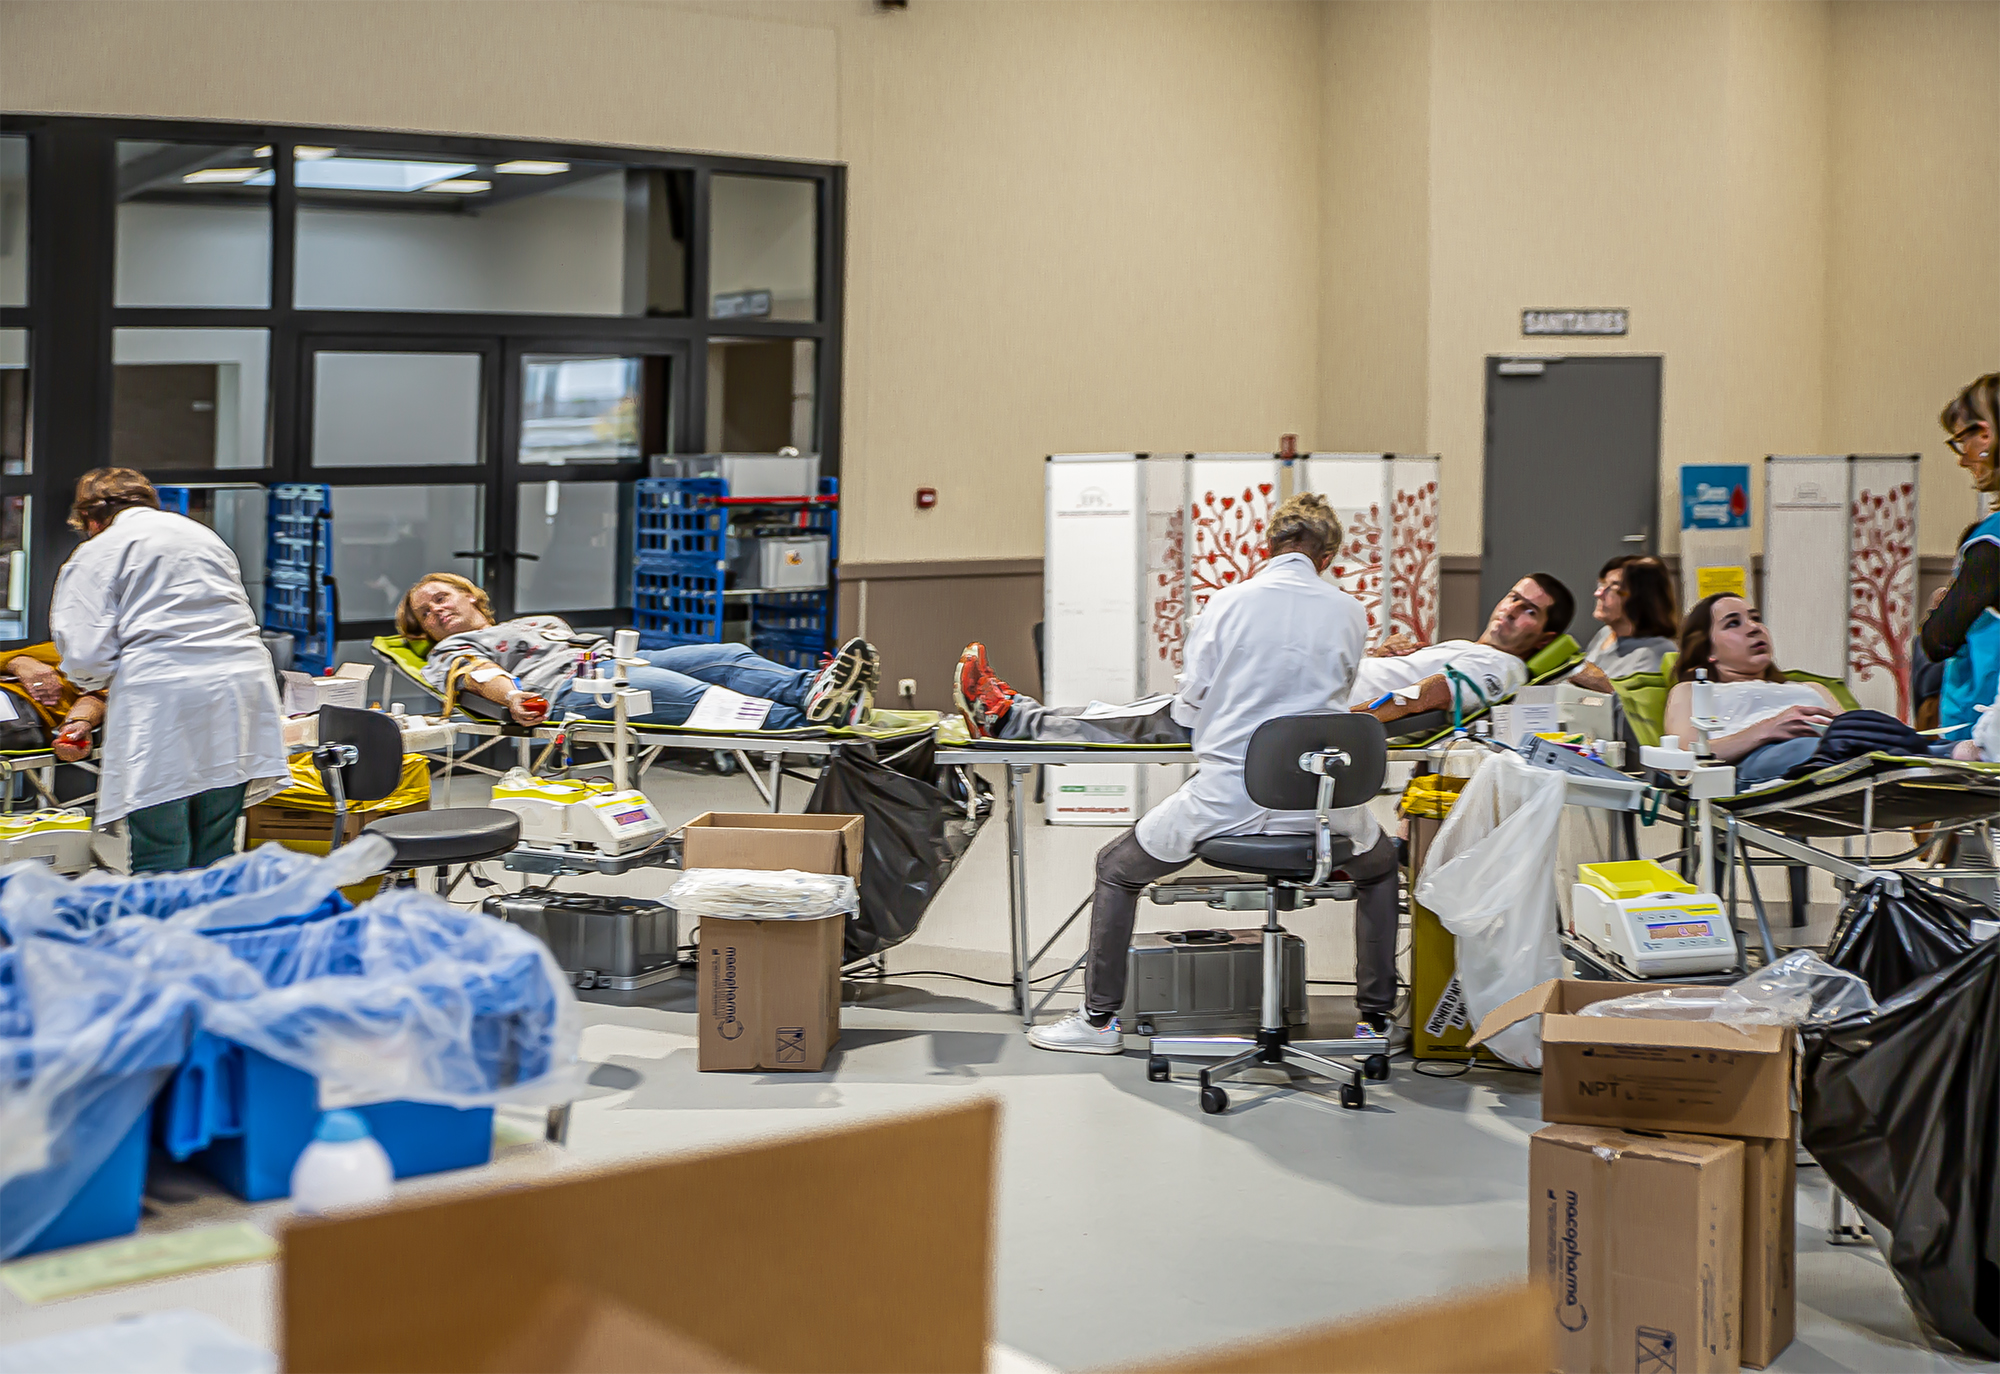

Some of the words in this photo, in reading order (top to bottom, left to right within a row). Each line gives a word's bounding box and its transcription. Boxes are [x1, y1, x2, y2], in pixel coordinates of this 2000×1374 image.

[722, 947, 739, 1024] macopharma
[1578, 1080, 1620, 1097] NPT
[1562, 1190, 1582, 1306] macopharma
